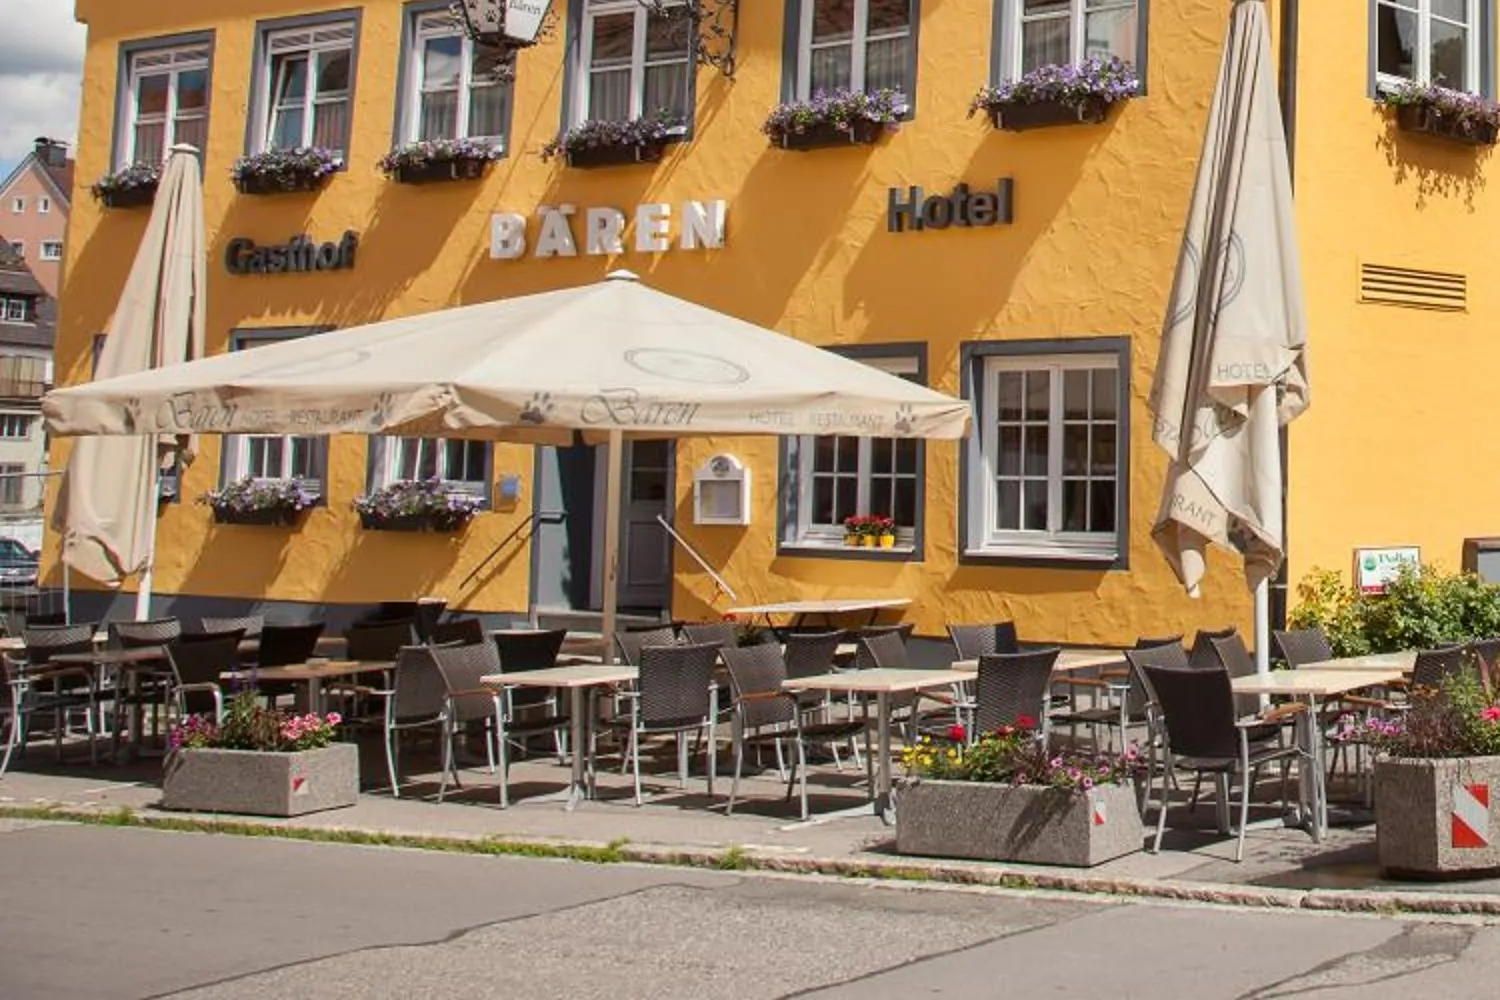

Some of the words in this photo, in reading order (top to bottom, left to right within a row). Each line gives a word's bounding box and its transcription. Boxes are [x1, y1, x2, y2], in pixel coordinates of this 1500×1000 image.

[490, 199, 727, 259] BÄREN
[887, 178, 1014, 232] Hotel
[225, 230, 359, 275] Gasthof
[579, 387, 702, 425] Bären
